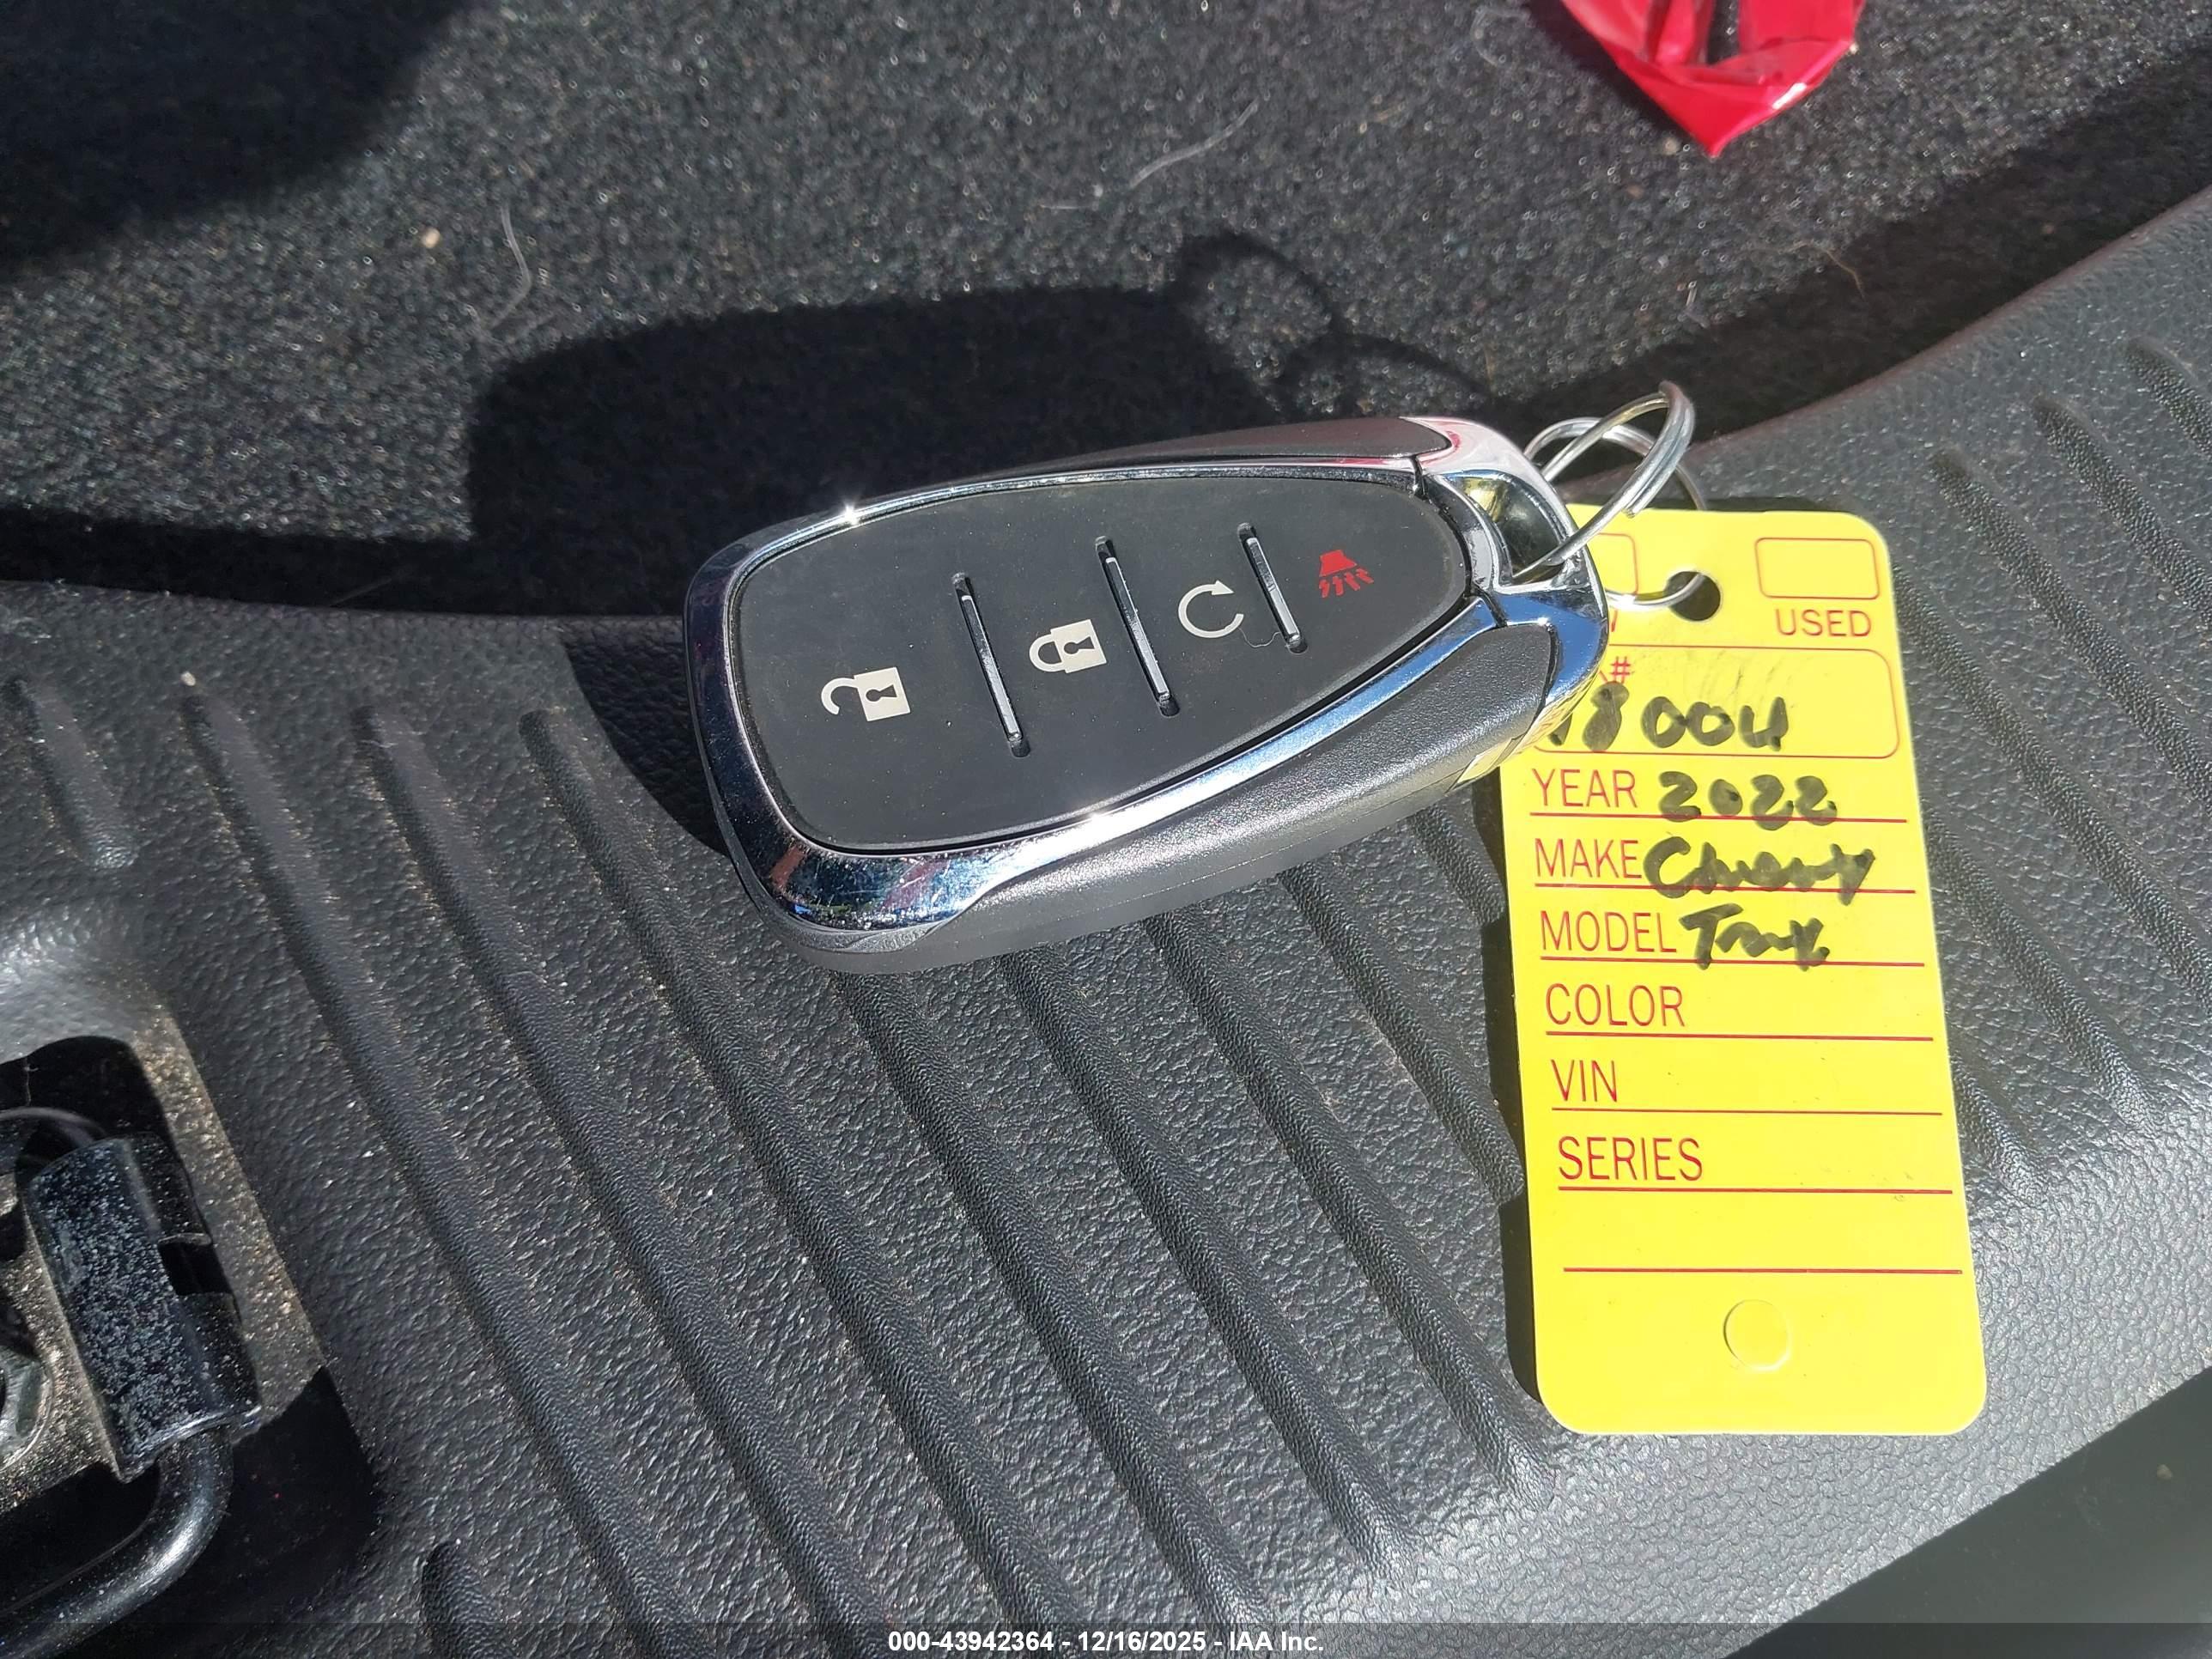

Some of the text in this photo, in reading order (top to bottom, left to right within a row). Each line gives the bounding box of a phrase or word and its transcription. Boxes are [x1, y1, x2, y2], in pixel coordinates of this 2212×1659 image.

[1775, 608, 1873, 639] USED
[1531, 768, 1638, 809] YEAR
[1658, 770, 1838, 831] 2022
[1534, 837, 1644, 880] MAKE
[1540, 909, 1678, 954] MODEL
[1545, 982, 1686, 1028] COLOR
[1550, 1058, 1619, 1103] VIN
[1557, 1134, 1705, 1182] SERIES
